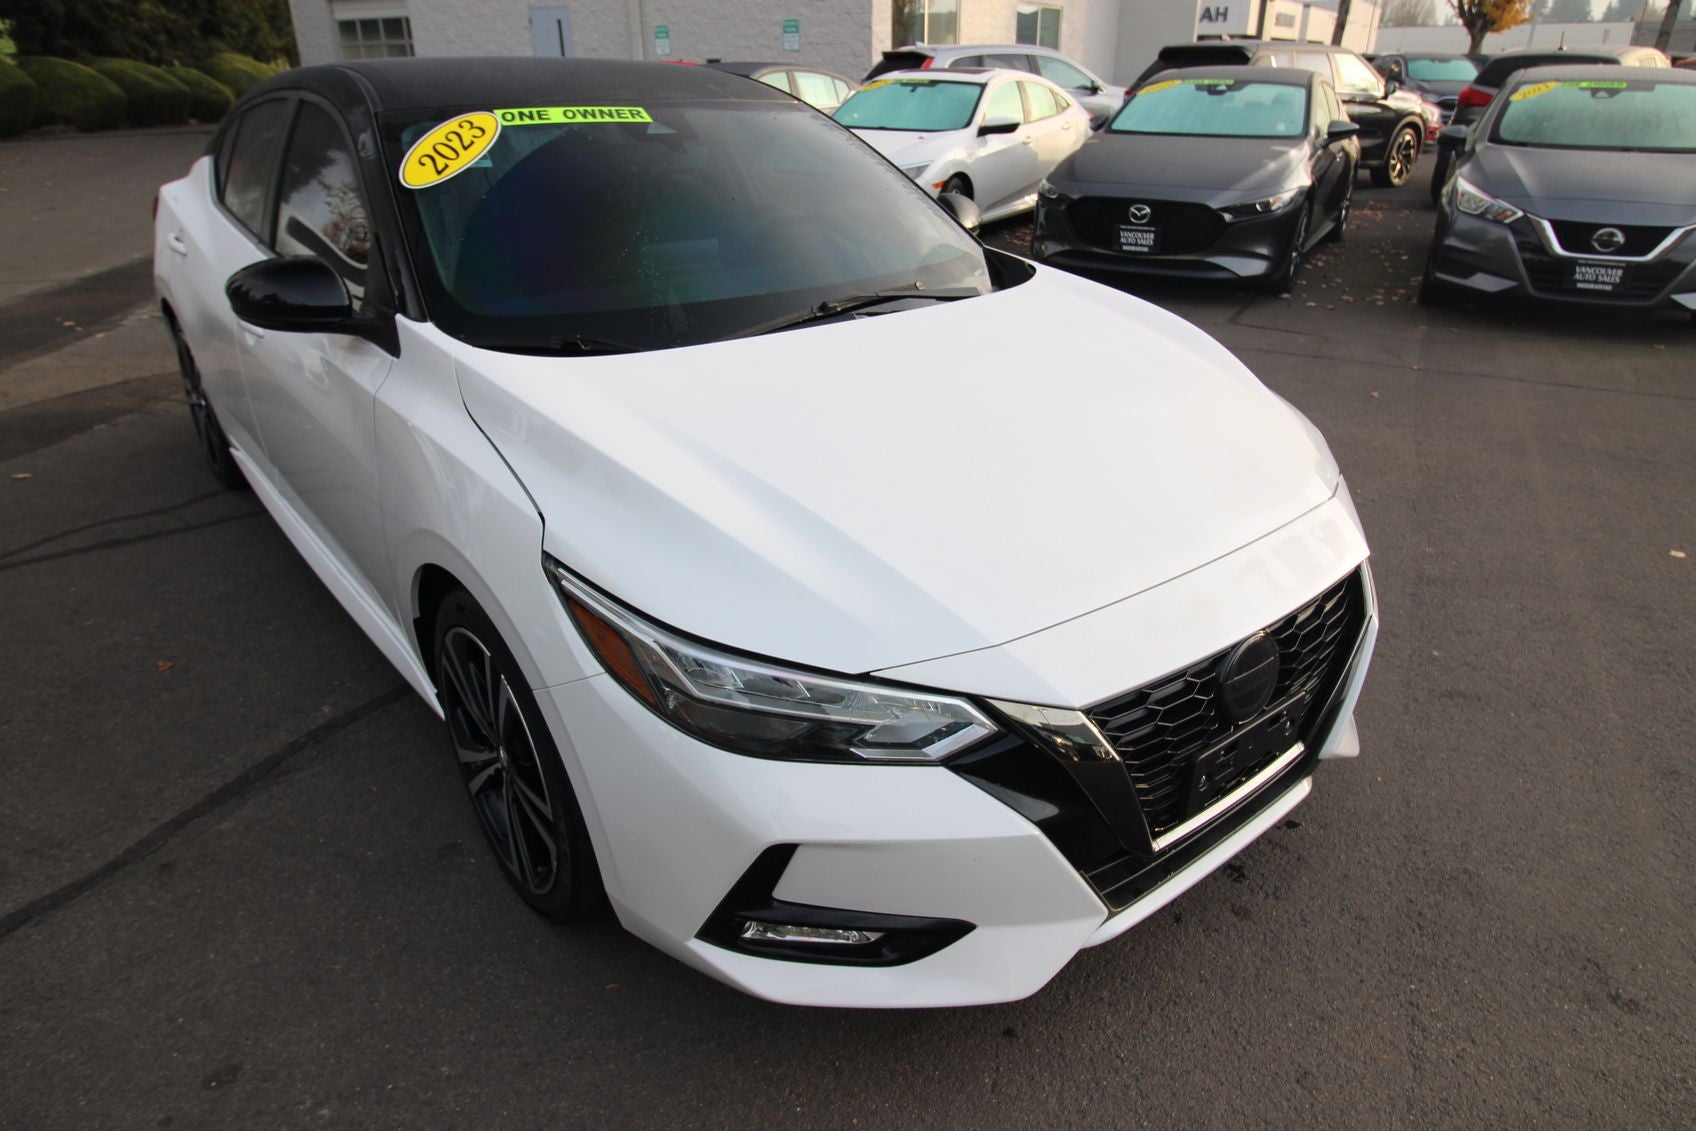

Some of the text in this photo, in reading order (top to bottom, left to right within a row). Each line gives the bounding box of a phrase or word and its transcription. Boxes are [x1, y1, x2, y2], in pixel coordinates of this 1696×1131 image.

[1200, 6, 1228, 22] AH
[501, 108, 643, 122] ONE OWNER
[418, 119, 486, 175] 2023
[1120, 230, 1155, 240] VANCOUVER
[1576, 265, 1623, 277] VANCOUVER
[1574, 273, 1620, 284] AUTO SALES
